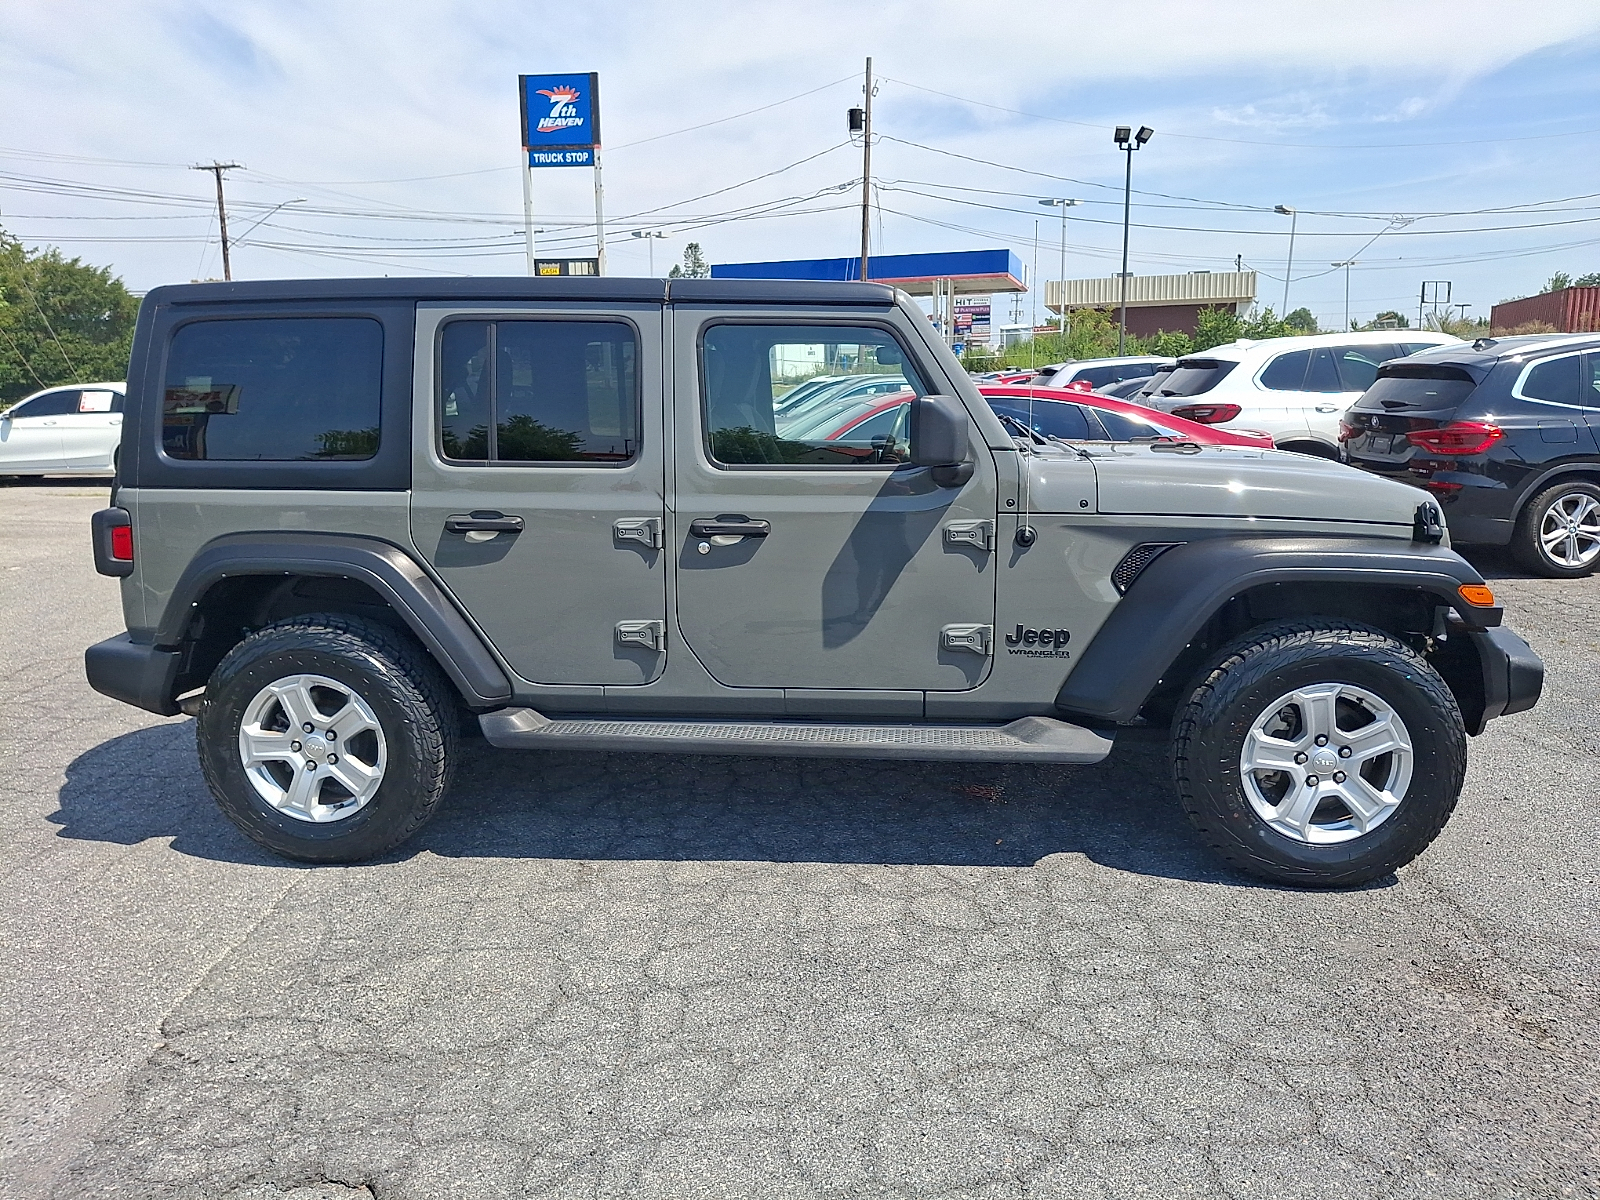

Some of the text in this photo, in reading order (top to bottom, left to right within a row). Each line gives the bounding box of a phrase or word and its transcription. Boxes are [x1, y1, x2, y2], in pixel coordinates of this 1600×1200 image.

[550, 94, 577, 118] 7th
[538, 117, 584, 129] HEAVEN
[533, 152, 589, 163] TRUCK STOP
[955, 298, 973, 306] HIT
[1005, 623, 1071, 649] Jeep
[1008, 648, 1070, 656] WRANGLER
